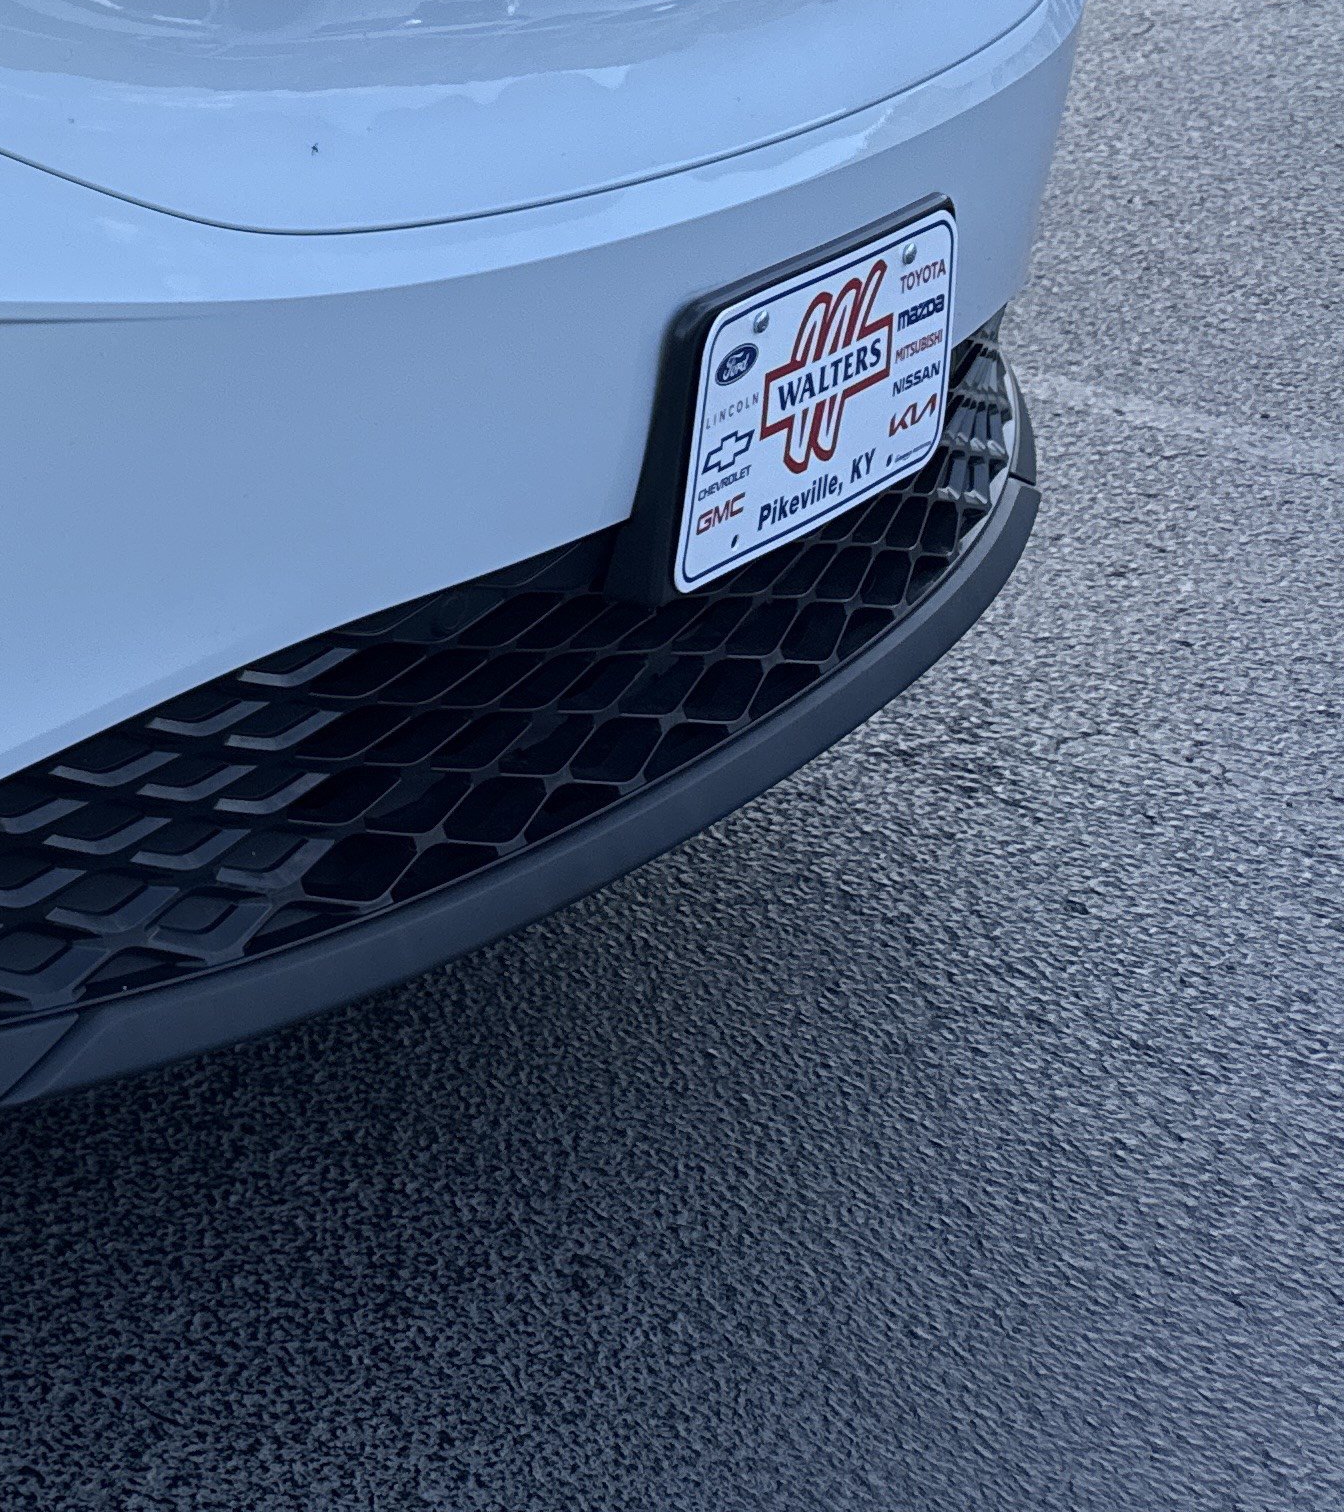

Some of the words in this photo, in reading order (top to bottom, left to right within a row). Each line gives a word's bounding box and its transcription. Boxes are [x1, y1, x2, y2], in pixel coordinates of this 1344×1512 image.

[900, 258, 947, 293] TOYOTA
[895, 328, 943, 364] MITSUBISHI
[777, 337, 882, 411] WALTERS
[892, 360, 941, 397] NISSAN
[705, 392, 759, 430] LINCOLN
[697, 464, 752, 502] CHEVROLET
[757, 473, 844, 531] Pikeville,
[850, 447, 877, 485] KY
[696, 492, 746, 536] GMC
